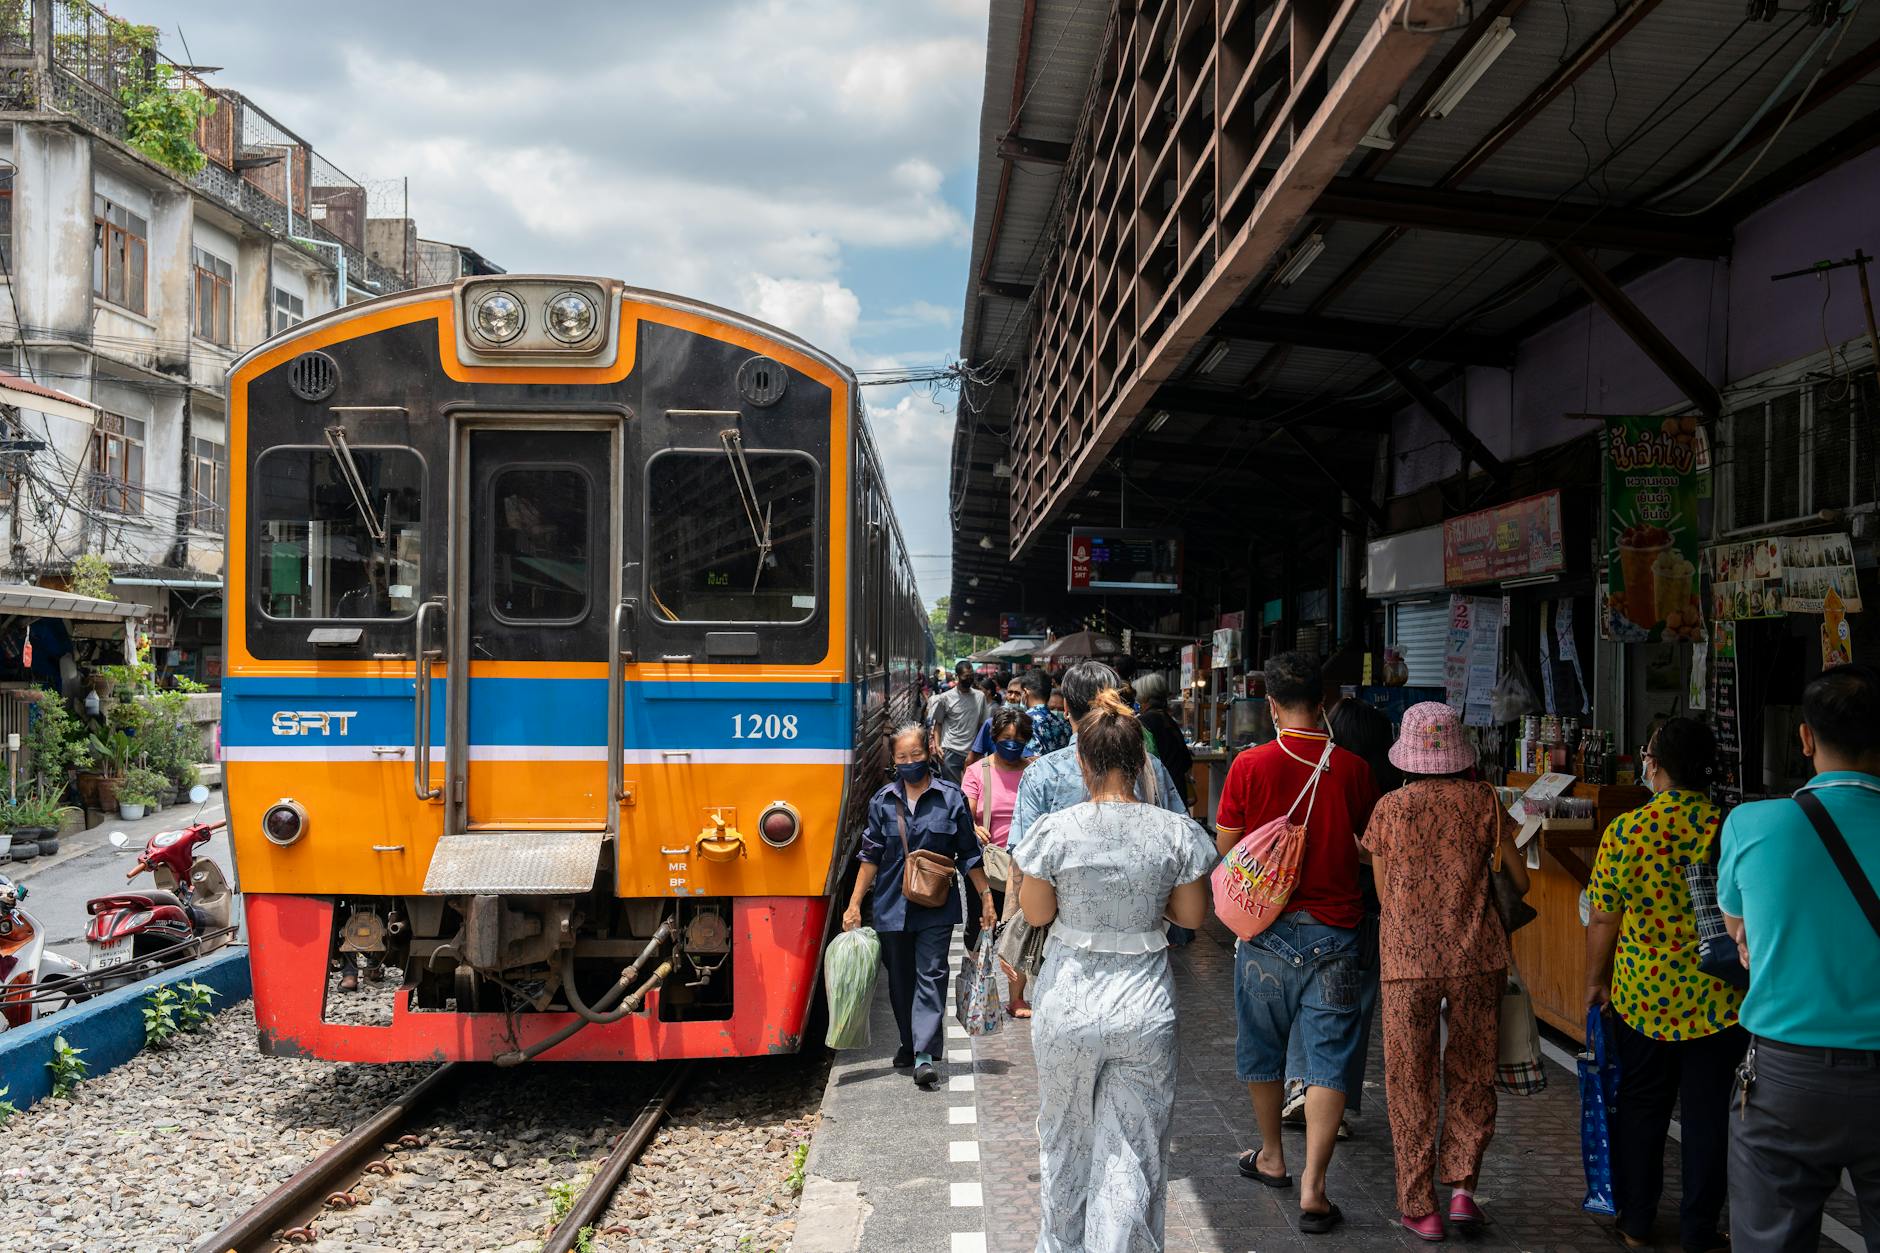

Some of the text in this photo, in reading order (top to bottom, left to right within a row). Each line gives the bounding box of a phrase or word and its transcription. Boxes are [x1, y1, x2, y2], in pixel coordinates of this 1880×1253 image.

[1610, 424, 1694, 474] น้ำลำไย
[1626, 476, 1679, 487] หวานหอม
[1456, 604, 1468, 618] 2
[1454, 618, 1470, 629] 72
[271, 710, 358, 736] SRT
[731, 713, 798, 740] 1208
[668, 862, 687, 871] MR
[1236, 843, 1265, 879] RUN
[669, 877, 686, 887] BP
[1222, 873, 1270, 919] HEART
[99, 956, 121, 968] 579
